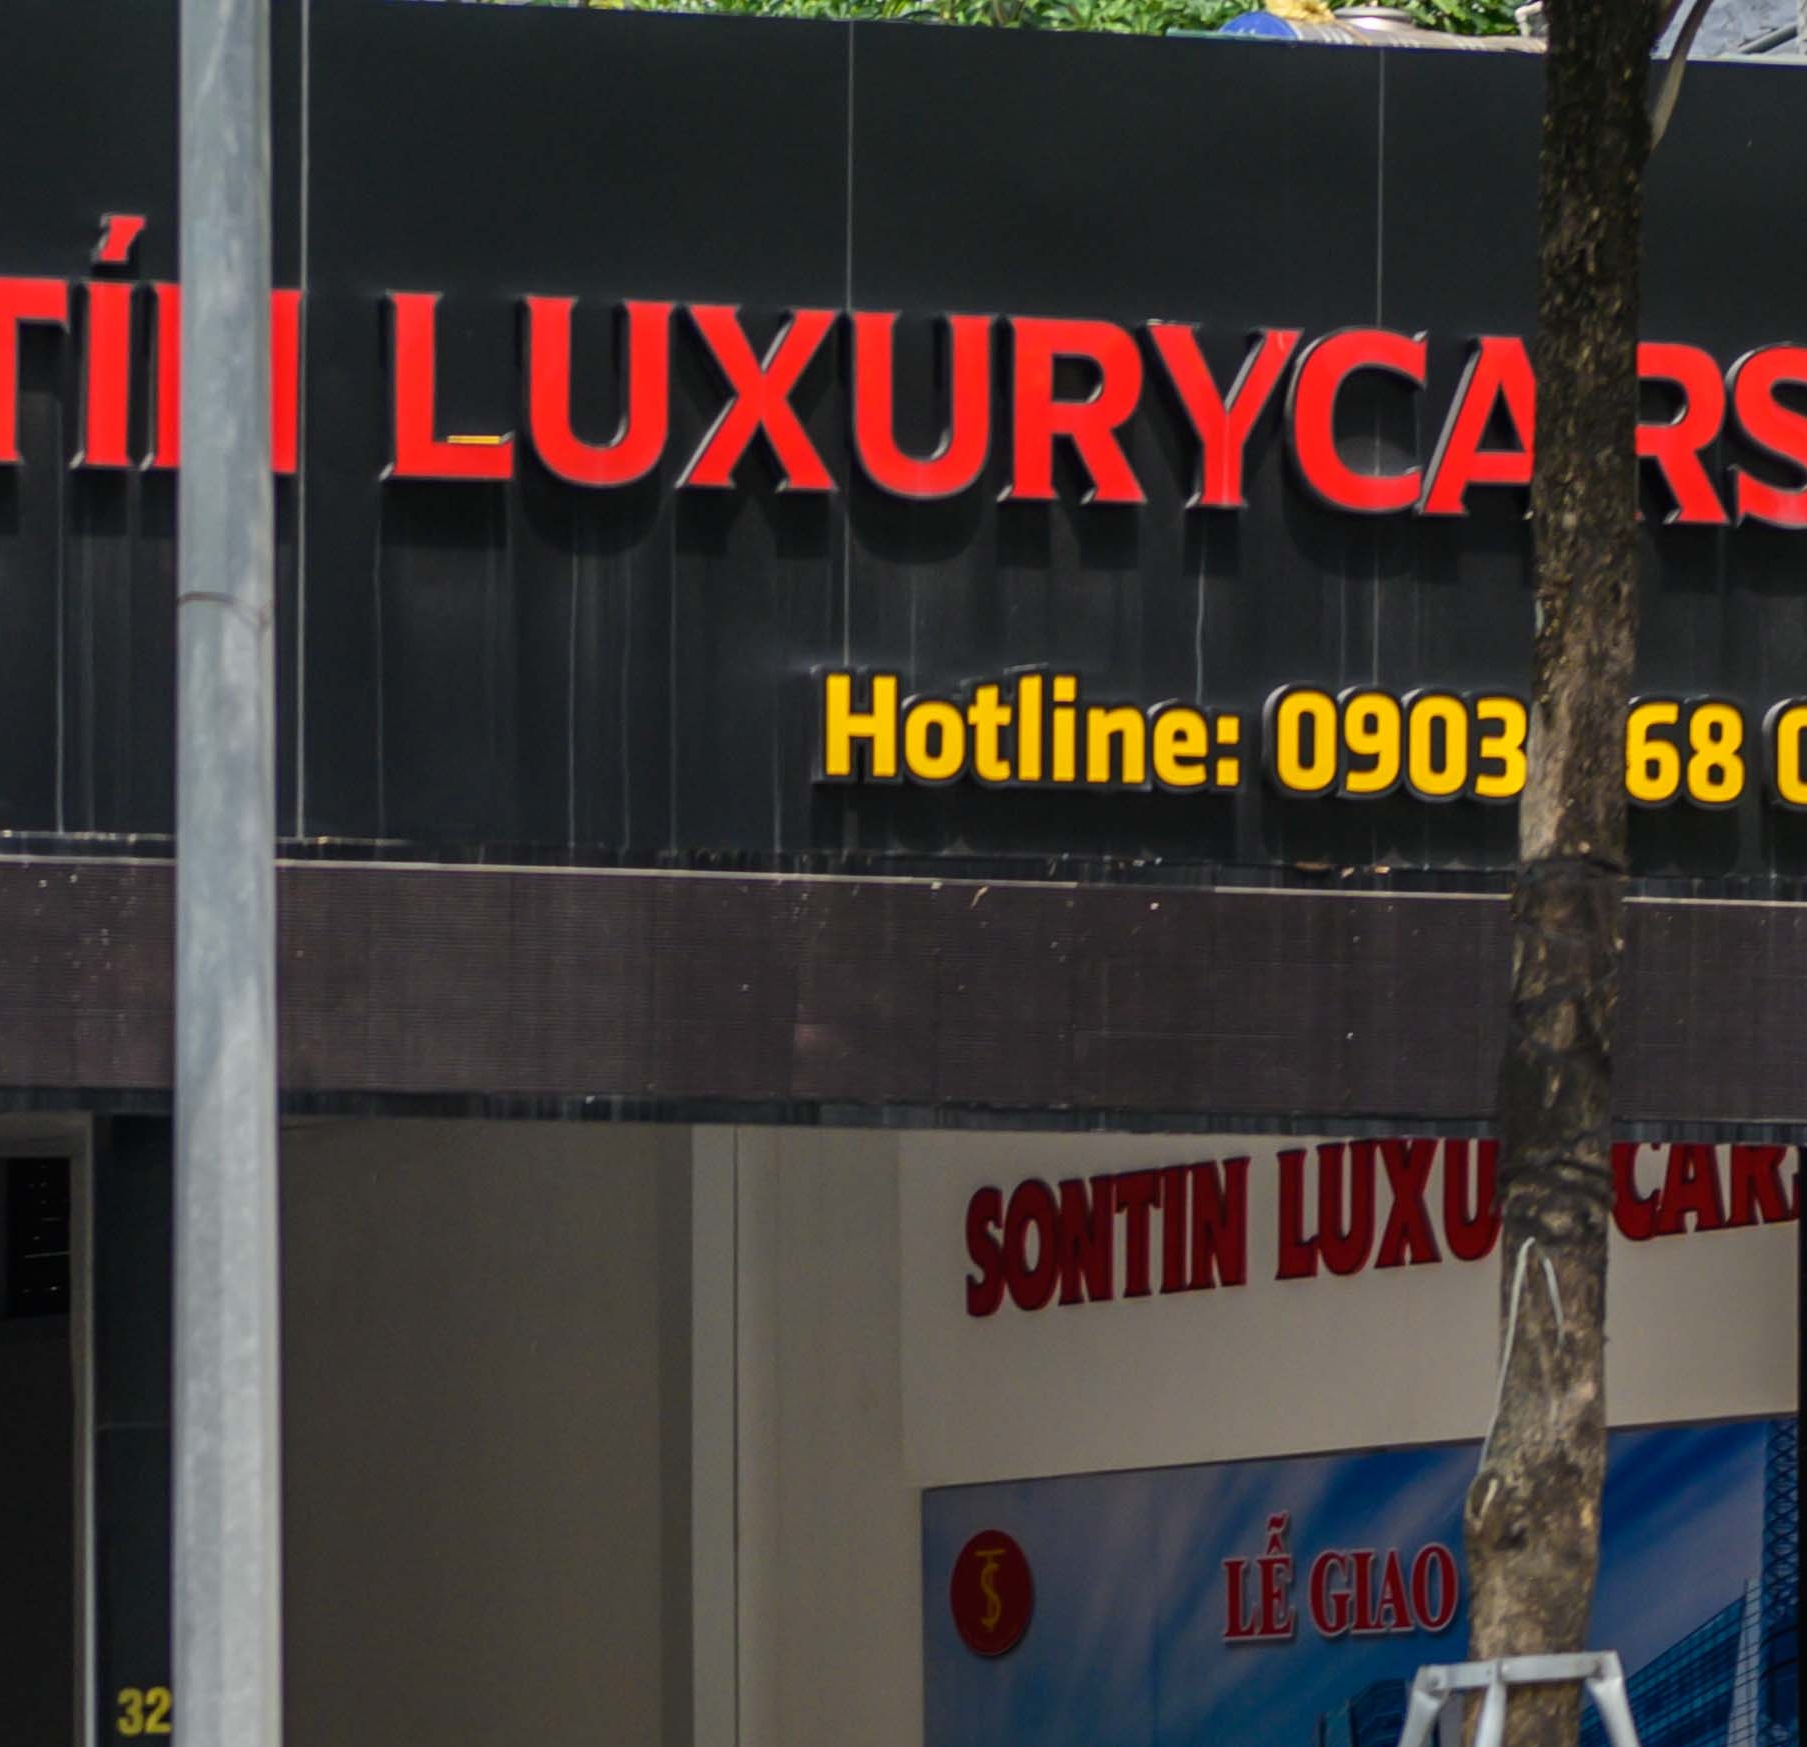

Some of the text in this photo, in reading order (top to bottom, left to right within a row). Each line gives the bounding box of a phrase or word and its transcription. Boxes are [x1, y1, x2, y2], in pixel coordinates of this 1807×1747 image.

[823, 672, 1241, 788] Hotline:
[1275, 690, 1529, 799] 0903
[1623, 700, 1745, 804] 68
[966, 1156, 1251, 1316] SONTIN
[1225, 1514, 1458, 1640] LỄ GIAO
